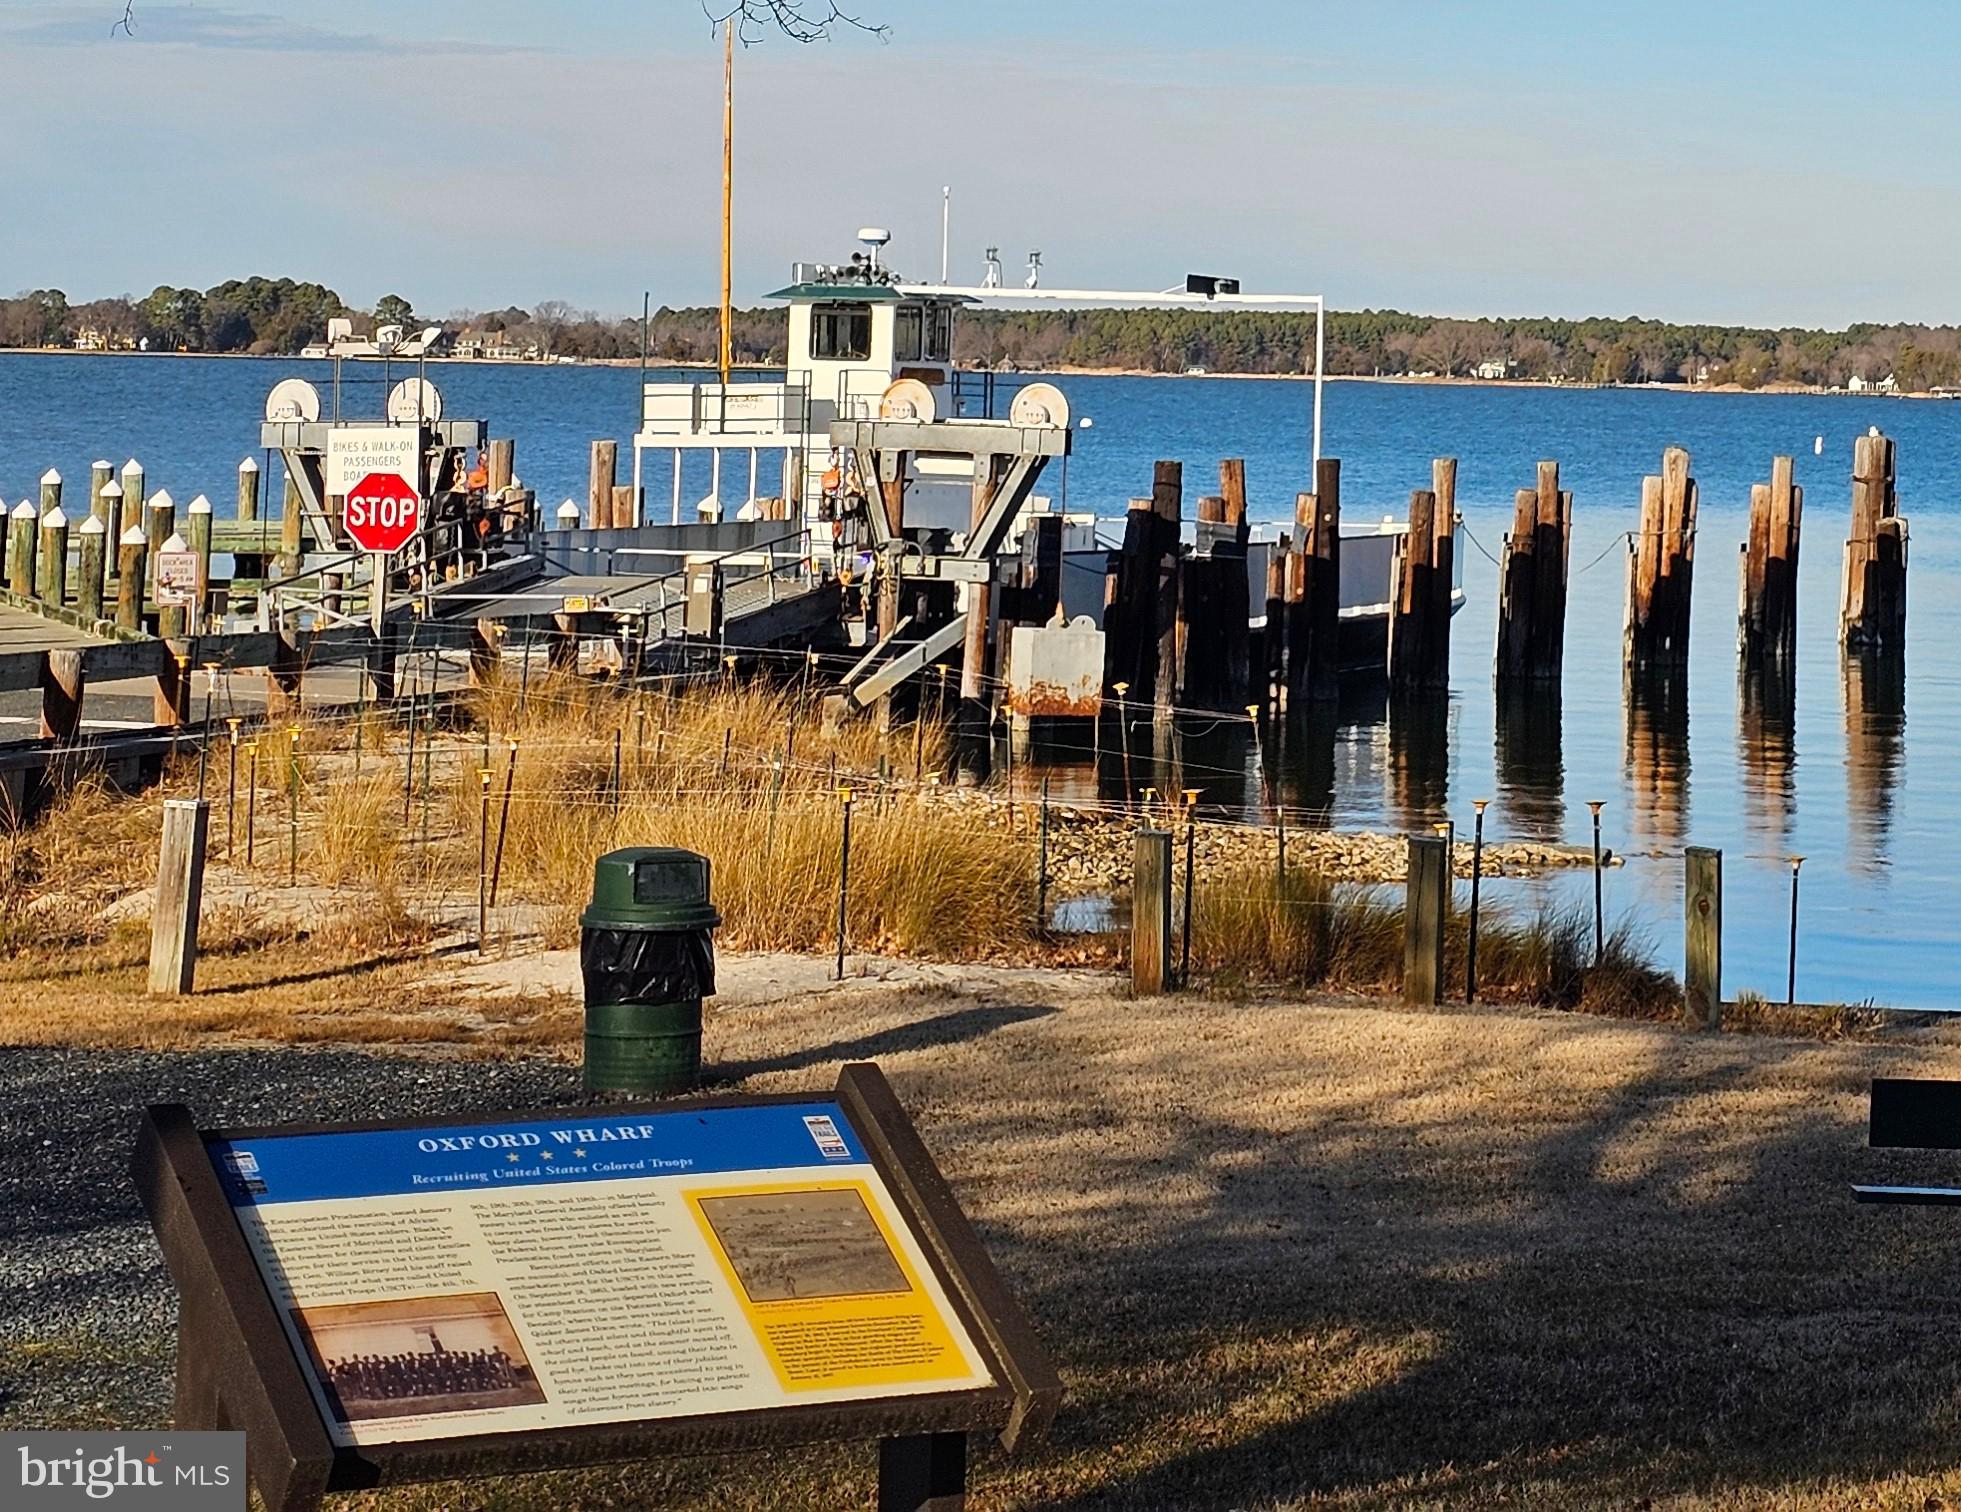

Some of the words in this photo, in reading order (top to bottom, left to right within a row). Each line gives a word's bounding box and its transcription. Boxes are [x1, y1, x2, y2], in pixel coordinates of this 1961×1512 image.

[333, 441, 359, 453] BIKES
[362, 442, 368, 452] &
[371, 440, 413, 452] WALK-ON
[343, 456, 402, 467] PASSENGERS
[349, 495, 416, 528] STOP
[418, 1132, 541, 1153] OXFORD
[549, 1125, 655, 1144] WHARF
[412, 1171, 489, 1184] Recruiting
[493, 1166, 541, 1179] United
[545, 1165, 588, 1175] States
[592, 1160, 644, 1172] Colored
[648, 1158, 693, 1169] Troops
